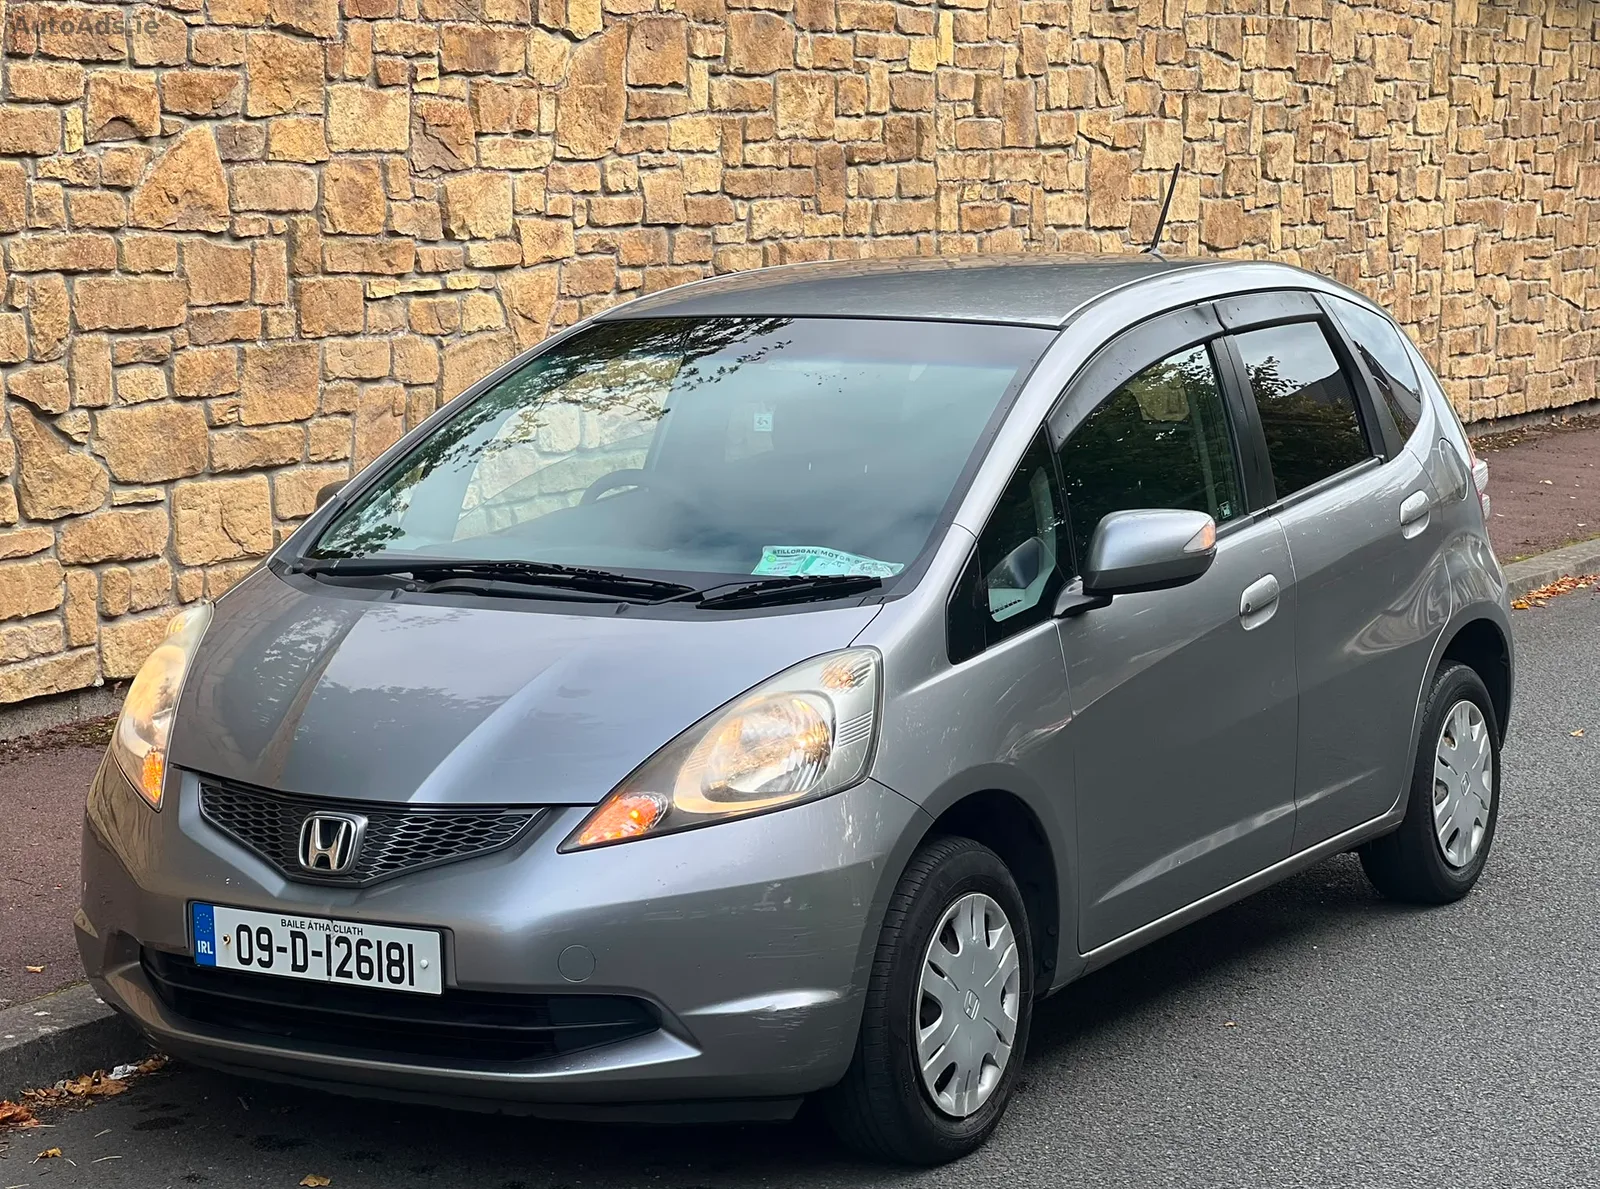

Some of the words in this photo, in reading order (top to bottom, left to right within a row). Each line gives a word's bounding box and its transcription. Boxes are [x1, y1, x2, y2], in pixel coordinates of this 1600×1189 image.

[281, 919, 305, 929] BAILE
[333, 924, 363, 936] CLIATH
[197, 940, 213, 955] IRL
[236, 923, 415, 986] 09-D-126181
